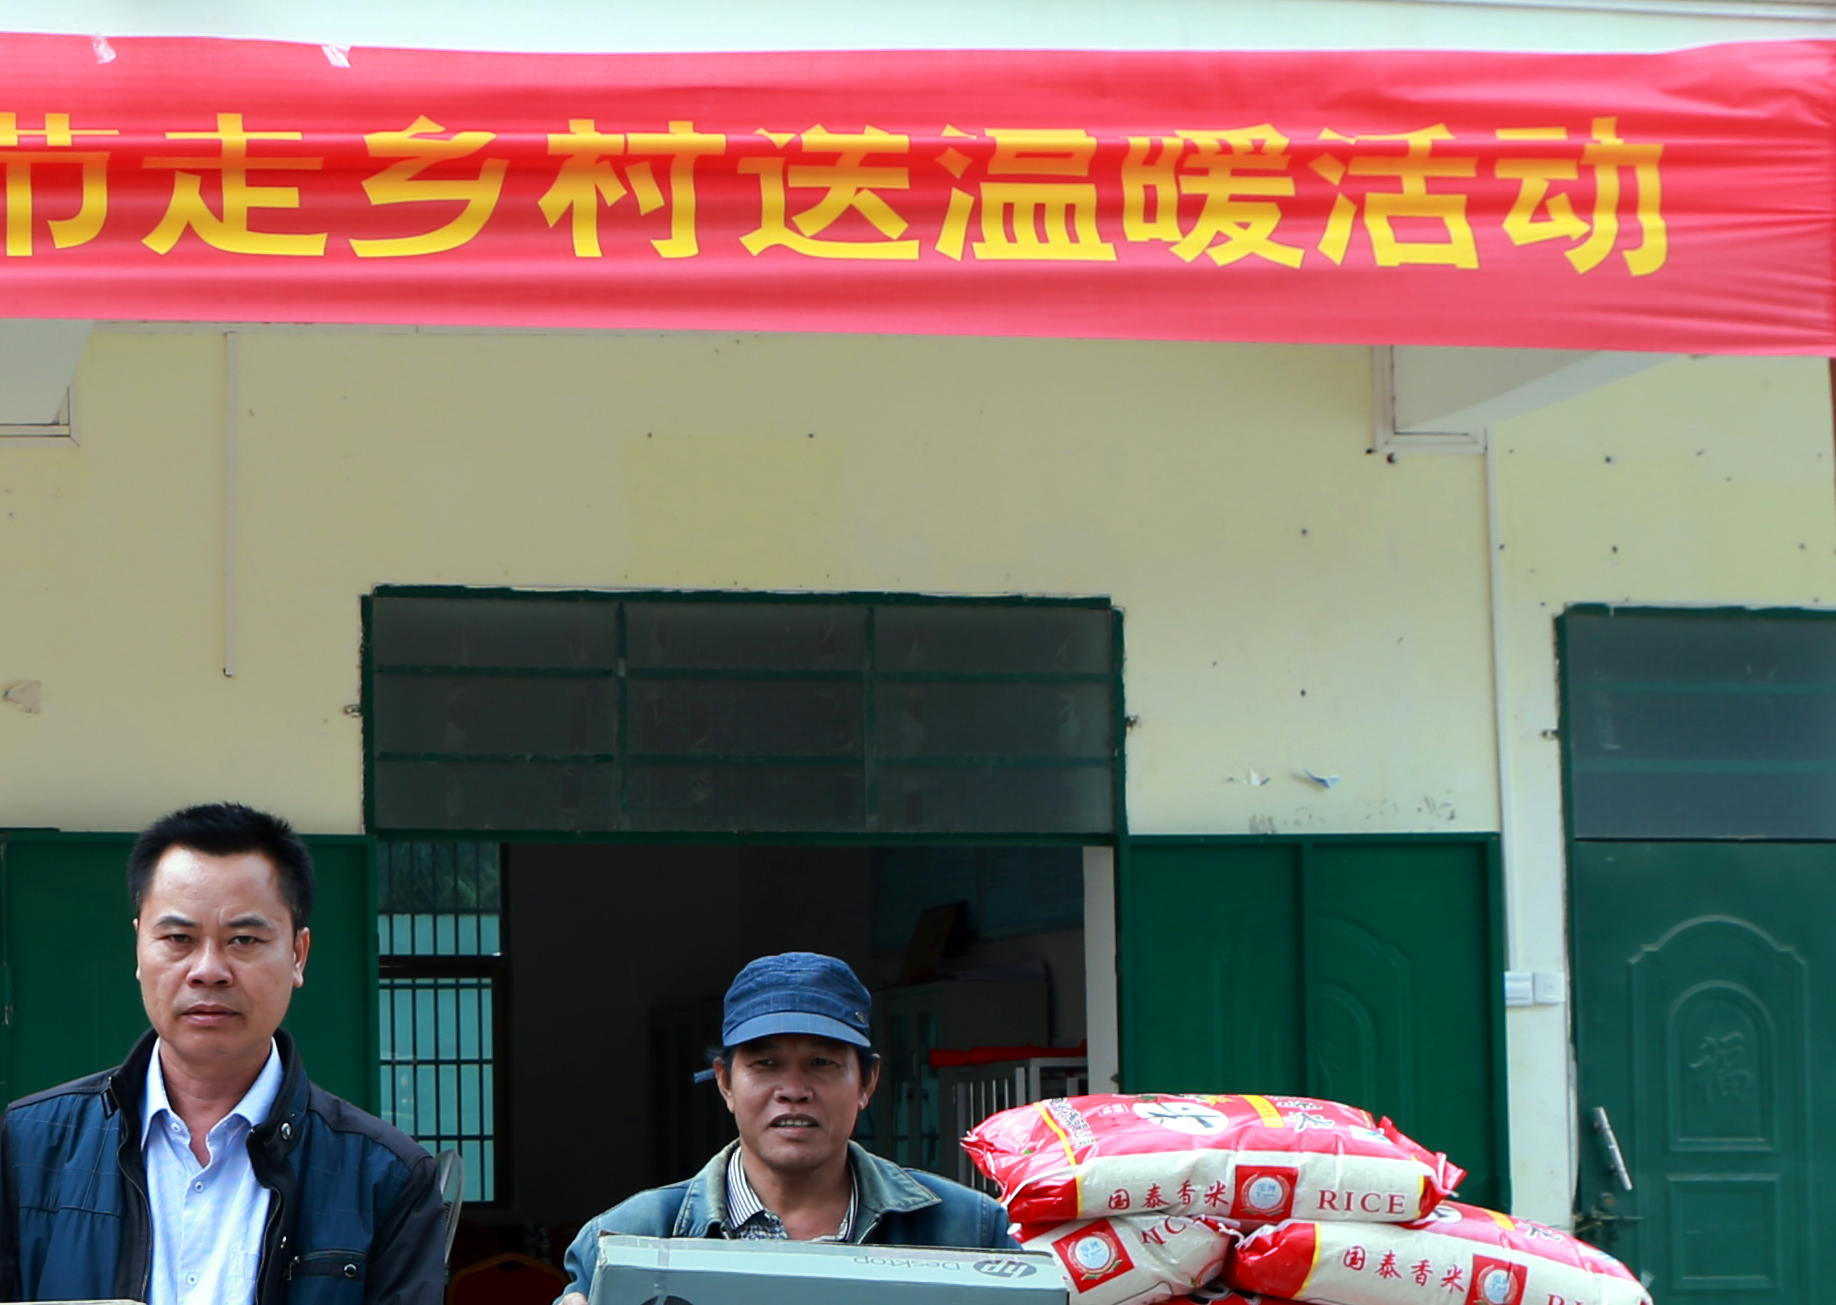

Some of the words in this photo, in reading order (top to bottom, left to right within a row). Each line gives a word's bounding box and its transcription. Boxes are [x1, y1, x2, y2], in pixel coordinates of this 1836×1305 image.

[1107, 1181, 1230, 1212] 国泰香米
[1317, 1190, 1406, 1216] RICE
[853, 1256, 960, 1271] Desktop
[1343, 1245, 1467, 1294] 国泰香米
